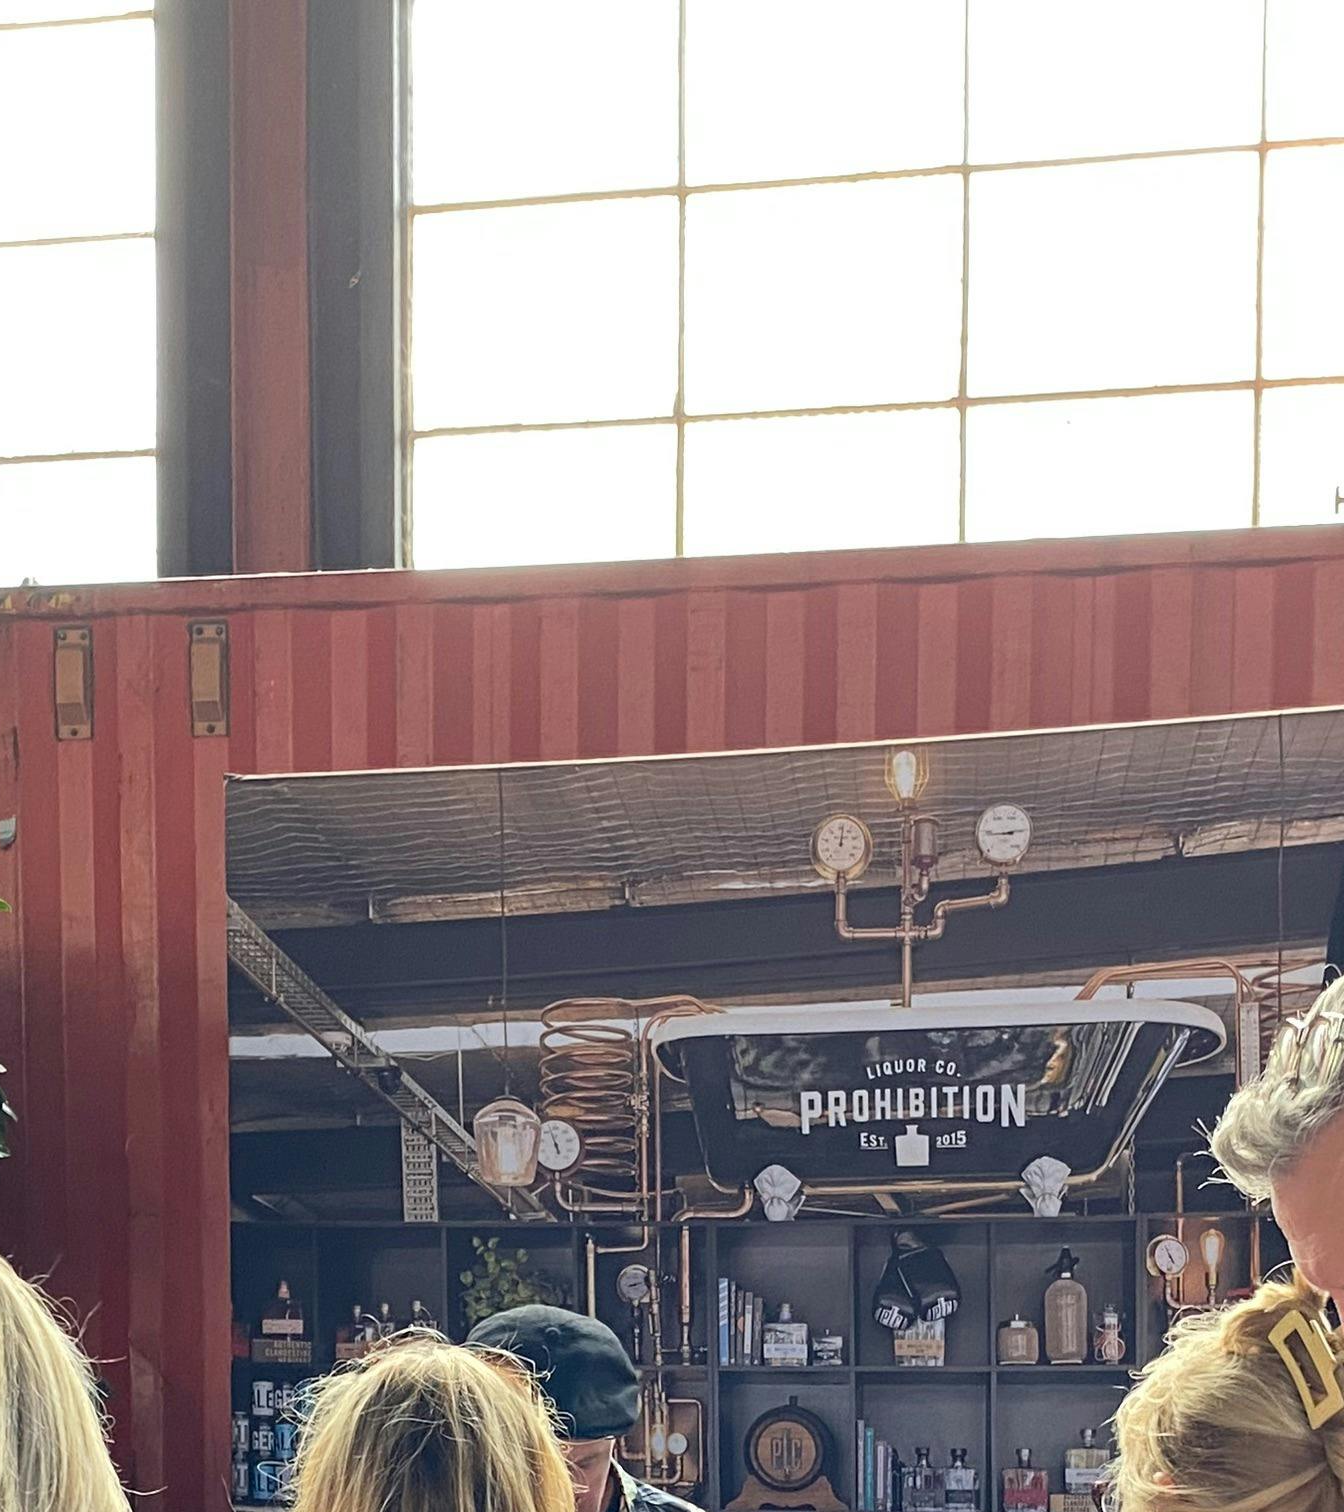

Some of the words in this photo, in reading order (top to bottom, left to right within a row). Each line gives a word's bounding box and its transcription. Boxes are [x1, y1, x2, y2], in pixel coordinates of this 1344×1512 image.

[866, 1058, 927, 1080] LIQUOR
[934, 1059, 962, 1078] CO.
[800, 1083, 1026, 1135] PROHIBITION
[935, 1130, 967, 1147] 2015
